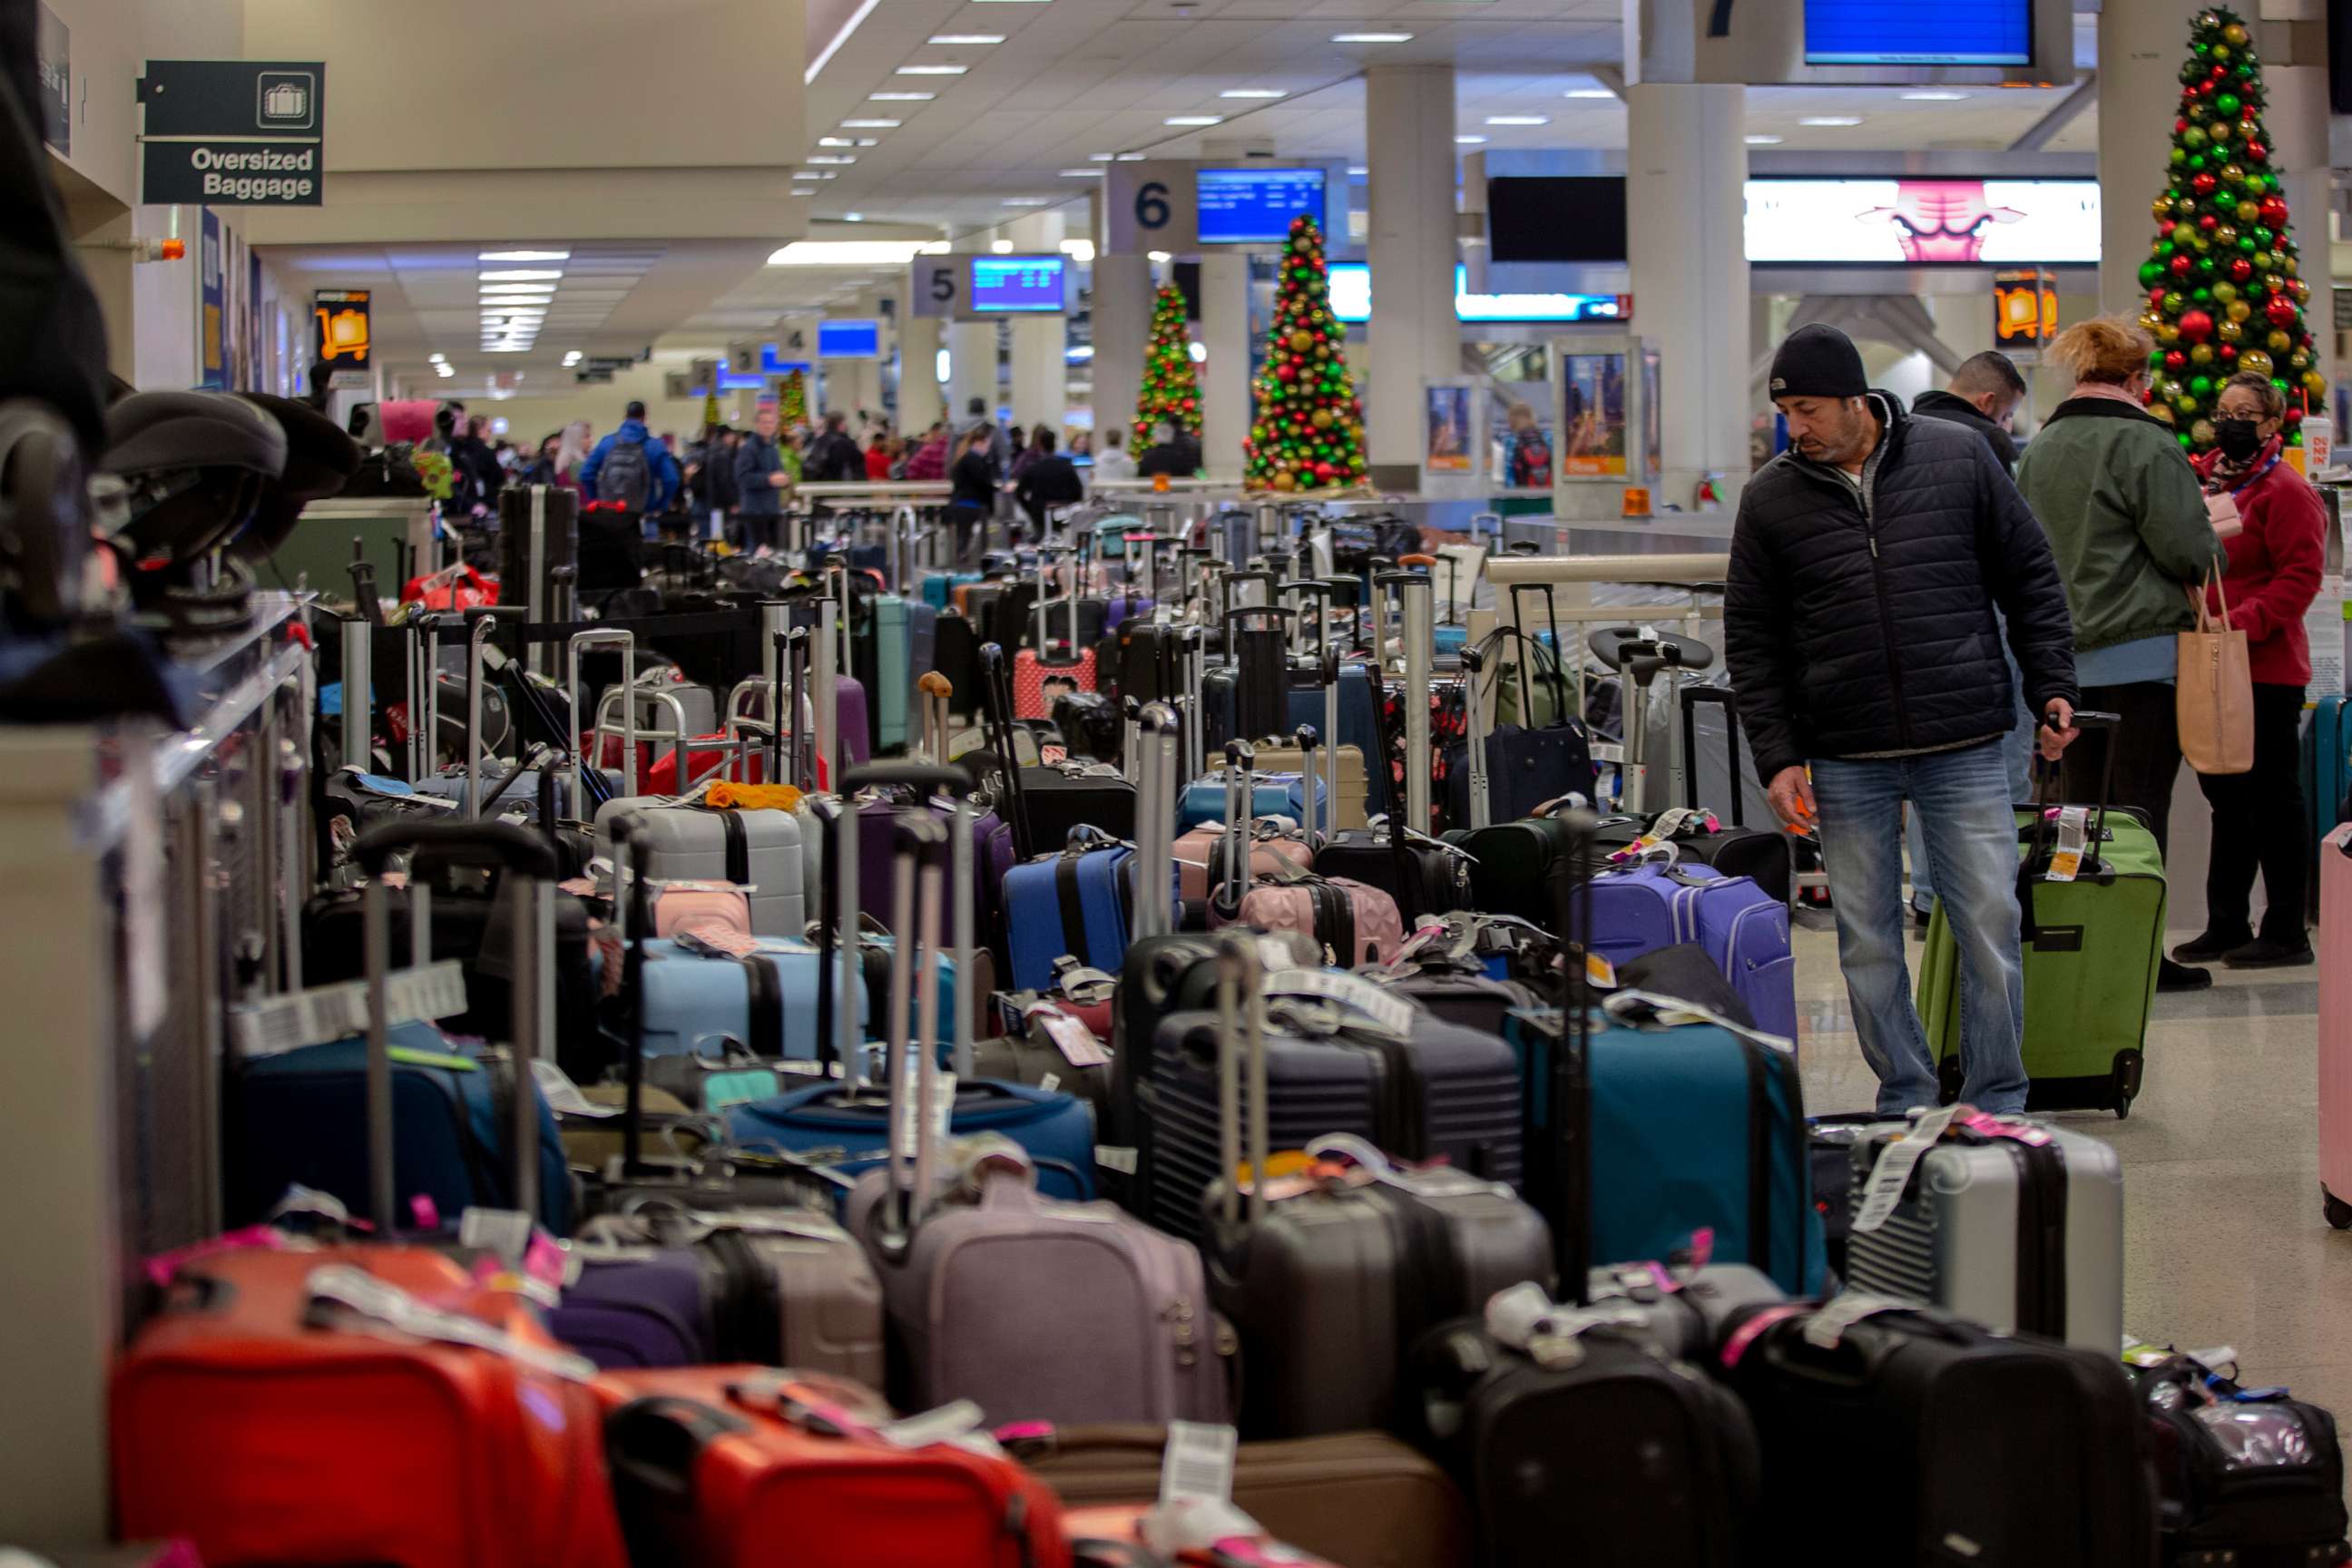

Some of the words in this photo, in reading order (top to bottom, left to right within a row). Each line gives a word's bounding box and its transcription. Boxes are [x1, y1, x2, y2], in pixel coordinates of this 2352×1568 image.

[191, 147, 313, 171] Oversized
[203, 173, 313, 200] Baggage
[1134, 181, 1171, 230] 6
[931, 269, 955, 302] 5
[789, 329, 804, 351] 4
